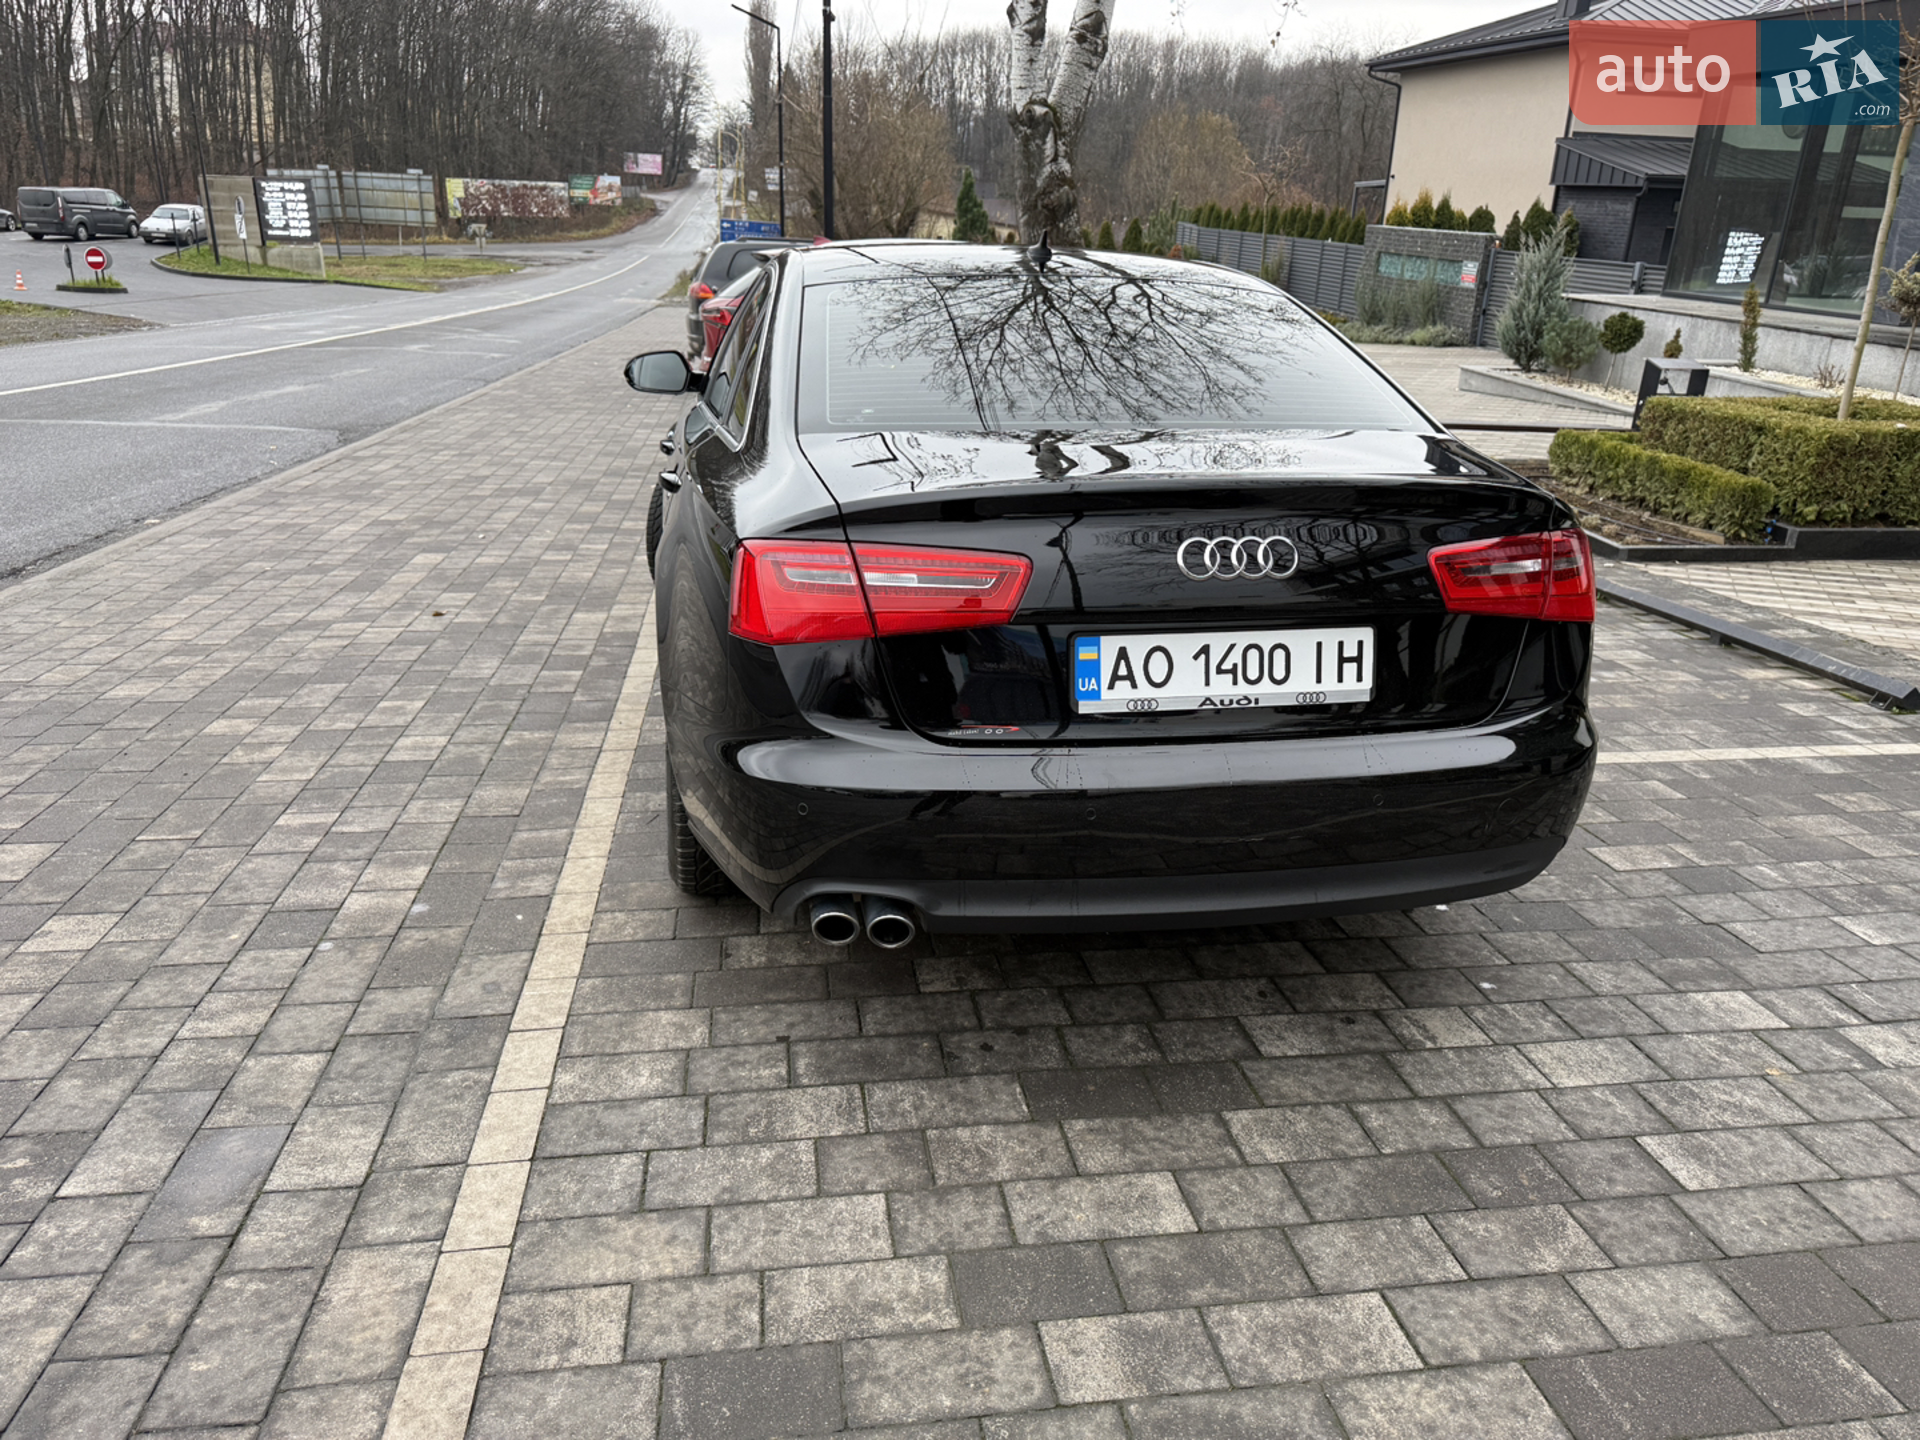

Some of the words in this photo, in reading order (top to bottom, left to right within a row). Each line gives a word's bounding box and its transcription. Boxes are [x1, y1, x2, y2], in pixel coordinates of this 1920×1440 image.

[1107, 645, 1174, 690] AO
[1192, 642, 1291, 687] 1400
[1316, 639, 1364, 684] IH
[1078, 677, 1099, 691] UA
[1198, 695, 1260, 708] Audi
